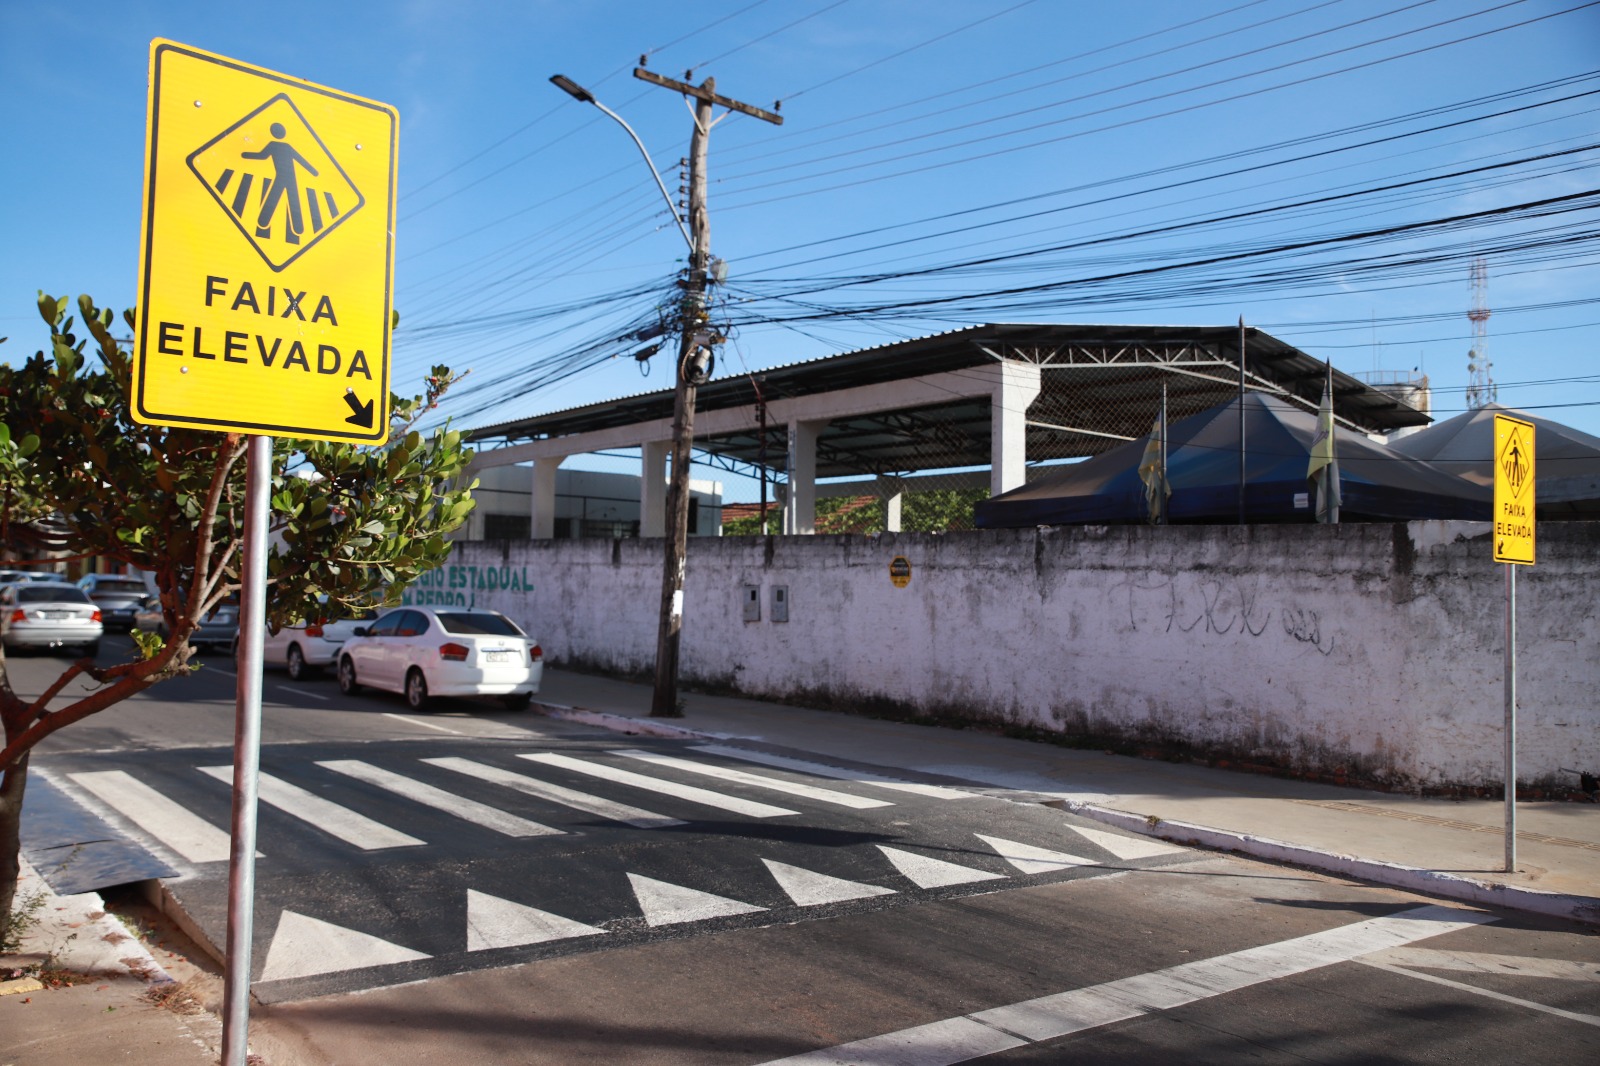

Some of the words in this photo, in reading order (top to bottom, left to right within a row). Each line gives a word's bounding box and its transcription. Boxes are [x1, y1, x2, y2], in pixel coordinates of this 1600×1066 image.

[204, 275, 339, 327] FAIXA
[158, 321, 373, 381] ELEVADA
[1505, 503, 1526, 518] FAIXA
[1498, 522, 1532, 538] ELEVADA
[449, 566, 535, 592] ESTADUAL
